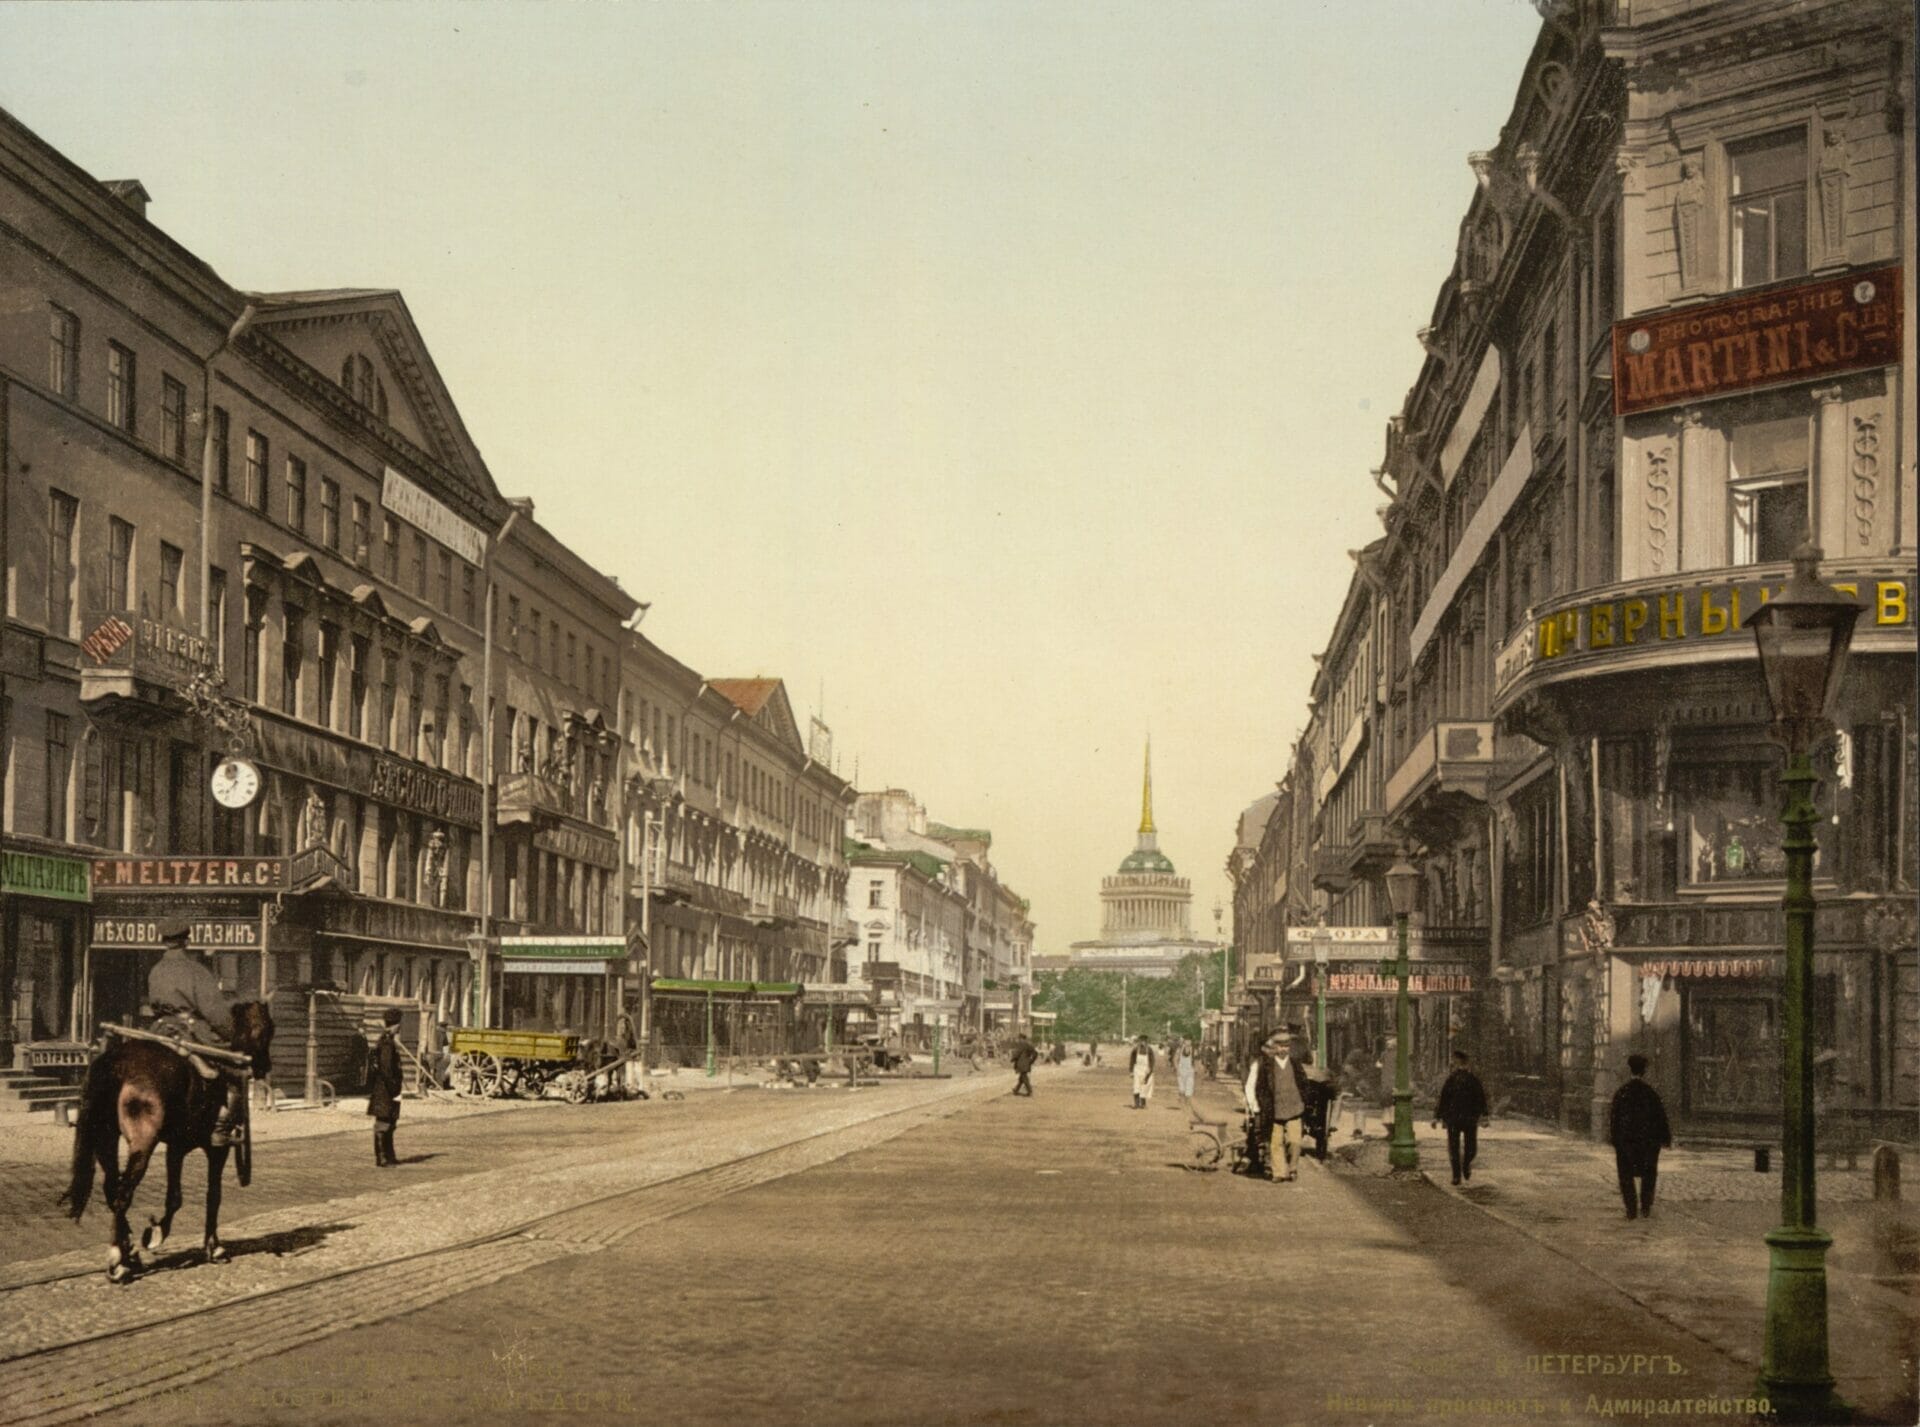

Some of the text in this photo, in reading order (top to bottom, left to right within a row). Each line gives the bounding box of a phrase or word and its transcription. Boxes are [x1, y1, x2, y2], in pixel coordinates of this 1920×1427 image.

[1656, 289, 1844, 343] PHOTOGRAPHIE
[115, 861, 239, 885] MELTZER
[188, 923, 256, 944] АГАЗИНЪ
[1297, 930, 1379, 940] ФОРА
[1330, 974, 1423, 992] МУЗЫКАЛЬАЯ
